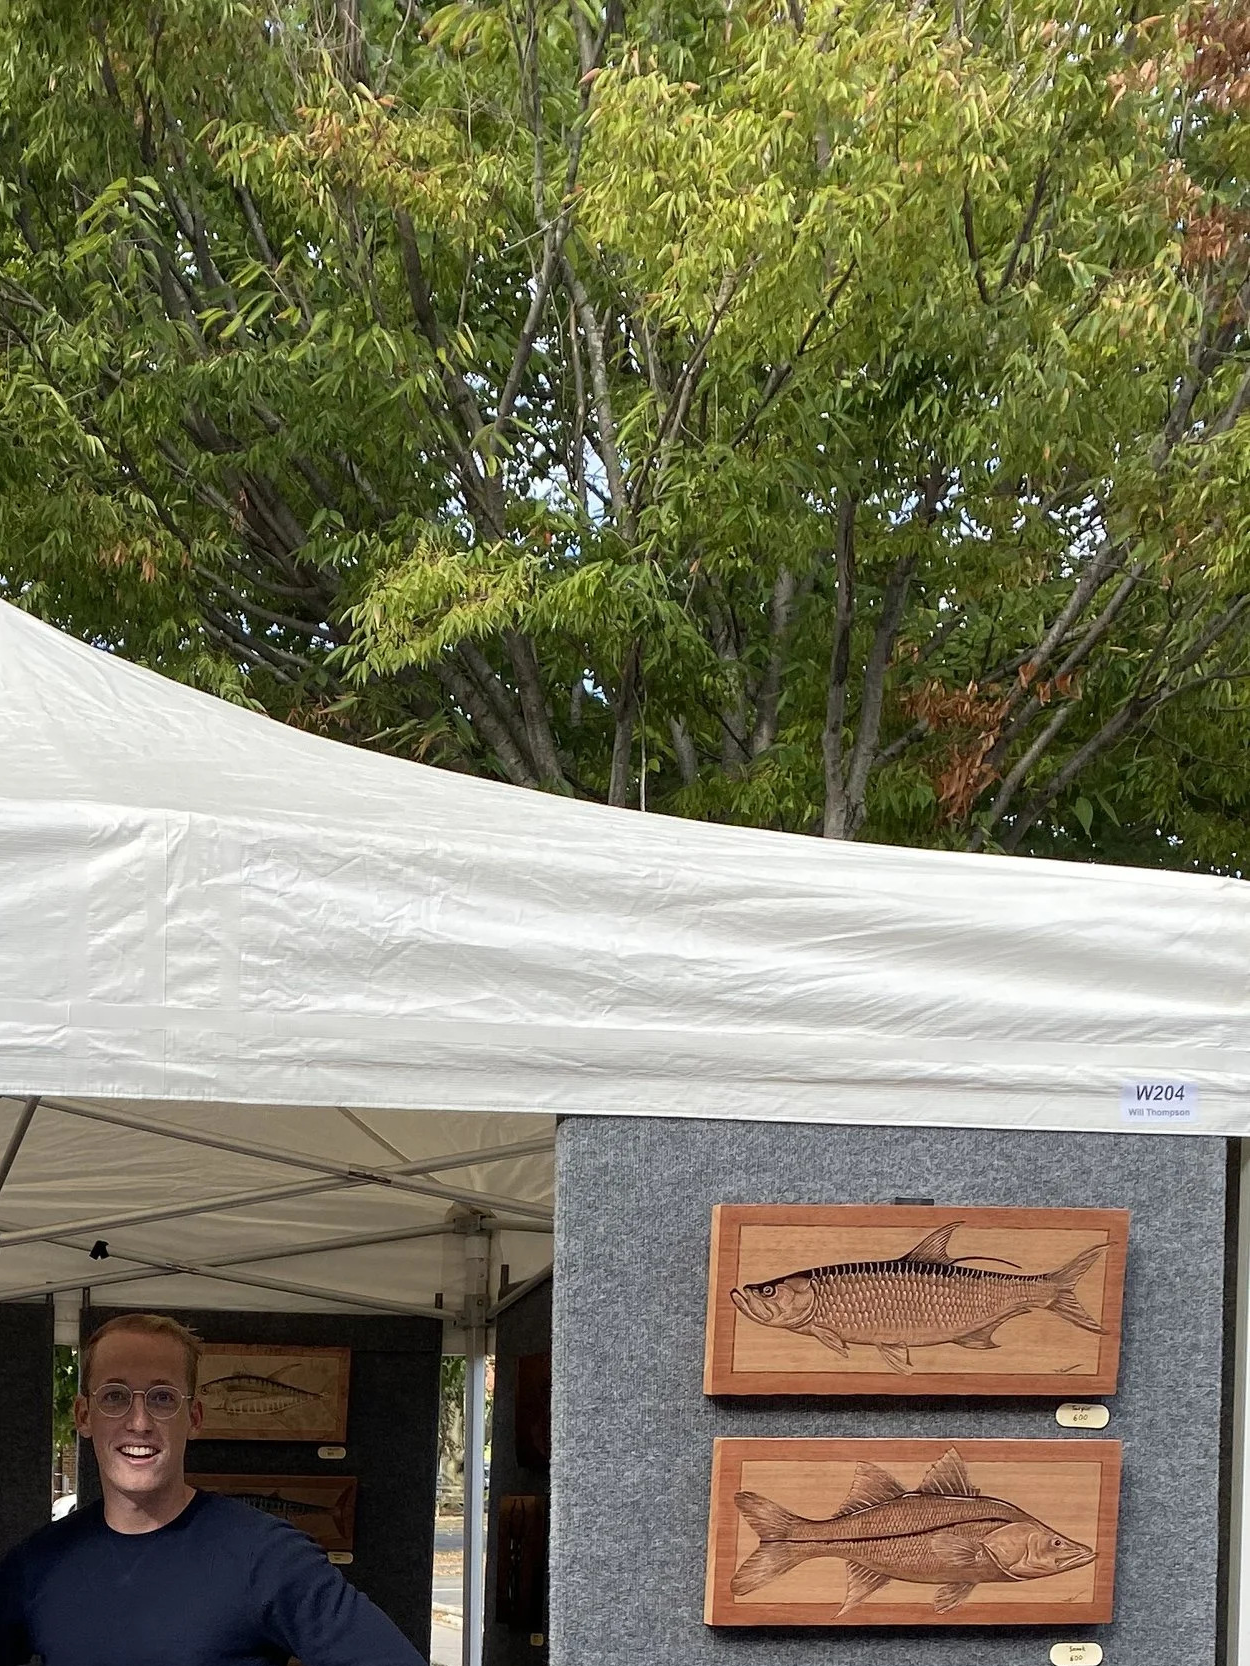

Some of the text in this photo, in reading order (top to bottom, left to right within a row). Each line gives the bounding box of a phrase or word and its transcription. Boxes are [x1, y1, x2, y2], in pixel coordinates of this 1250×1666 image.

[1136, 1085, 1185, 1101] W204
[1128, 1108, 1191, 1118] Will Thompson
